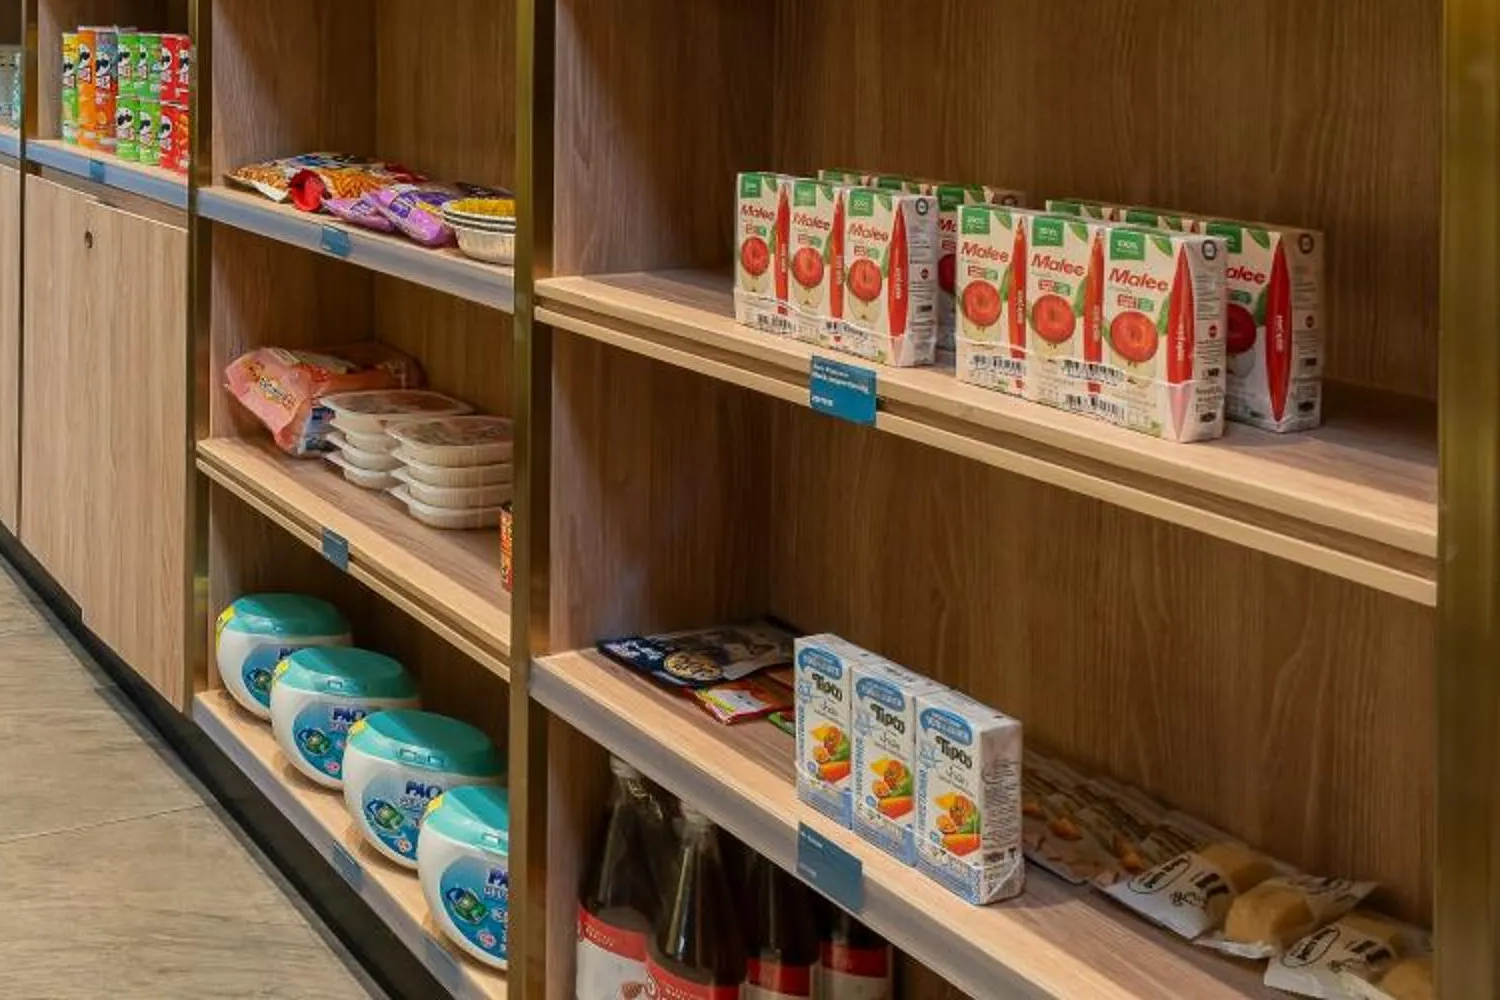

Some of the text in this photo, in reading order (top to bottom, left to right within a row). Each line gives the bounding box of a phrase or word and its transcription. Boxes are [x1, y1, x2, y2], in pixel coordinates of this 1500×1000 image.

[961, 241, 1009, 263] Malee
[1031, 253, 1084, 277] Malee
[1225, 264, 1267, 285] alee
[1109, 267, 1169, 293] Malee
